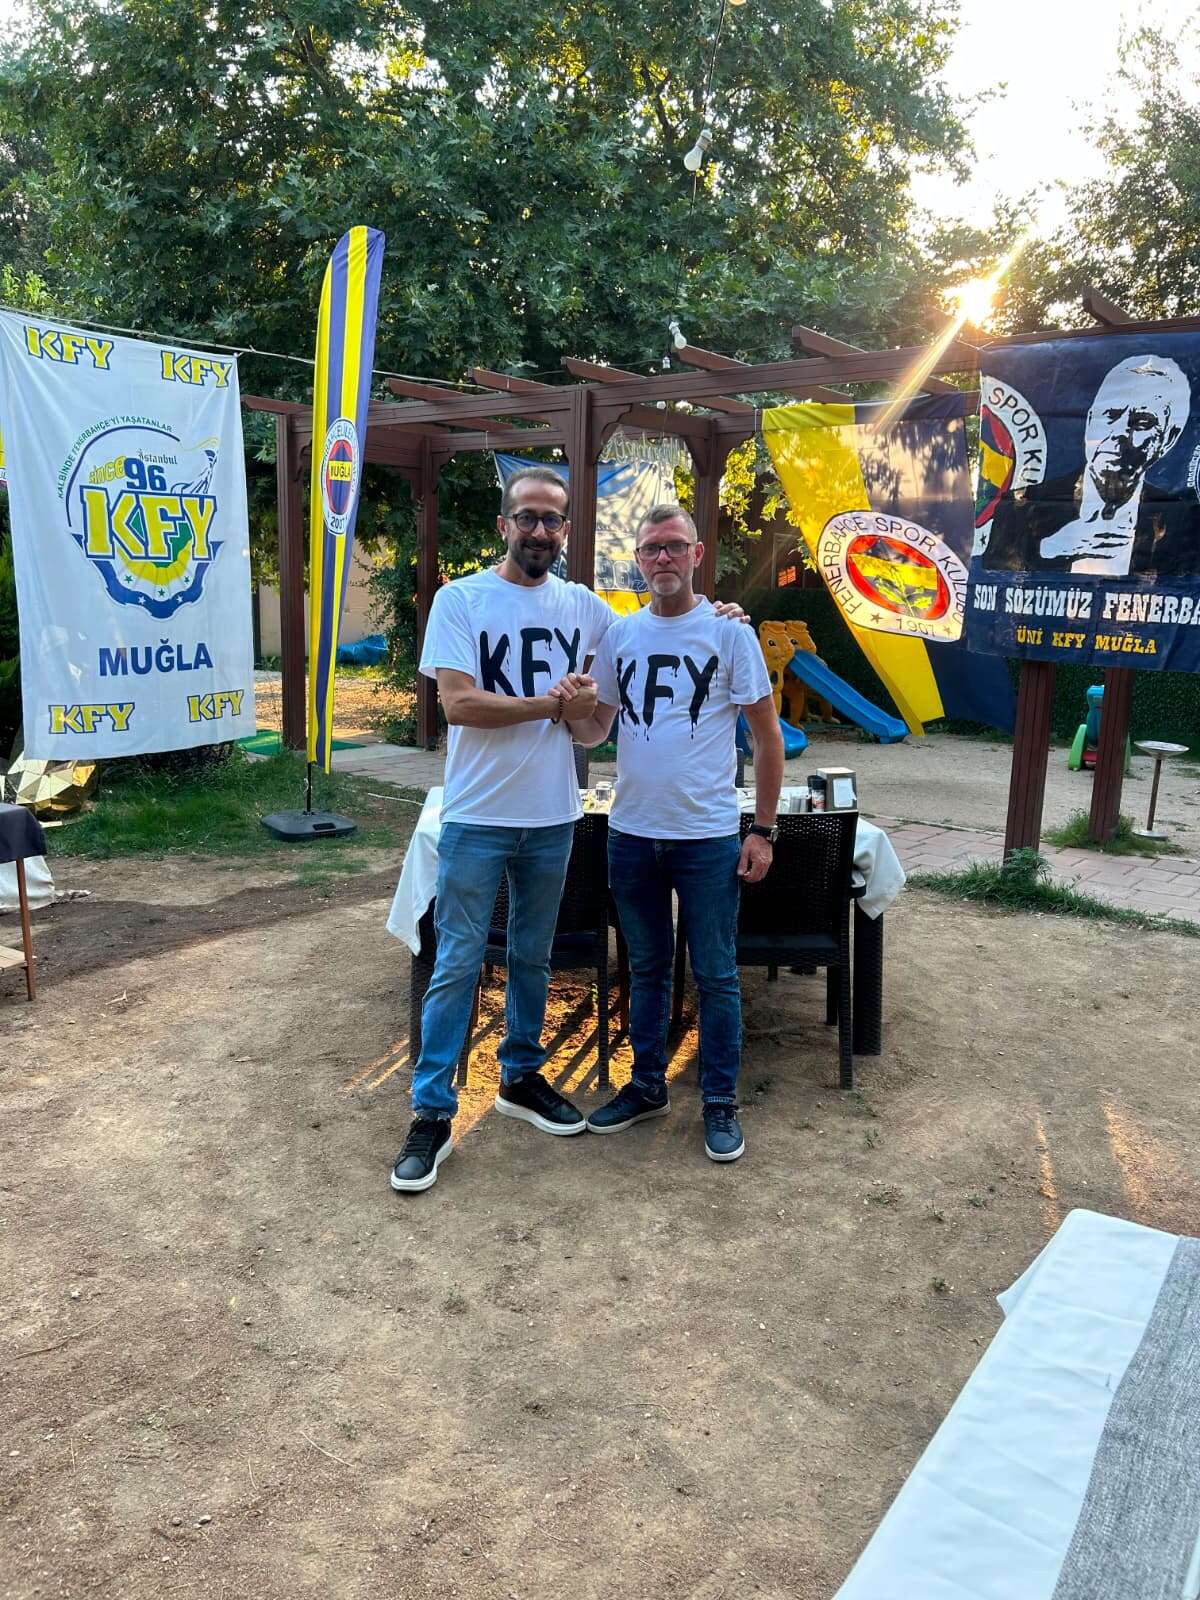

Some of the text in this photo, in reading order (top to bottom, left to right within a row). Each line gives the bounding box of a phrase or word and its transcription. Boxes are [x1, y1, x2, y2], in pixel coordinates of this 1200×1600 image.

[24, 326, 114, 370] KFY
[161, 350, 232, 388] KFY
[120, 415, 173, 432] YAŞATANLAR
[988, 387, 1039, 443] SPOR
[123, 457, 167, 491] 96
[79, 485, 218, 561] KFY
[874, 517, 936, 552] SPOR
[974, 584, 998, 611] SON
[1005, 586, 1093, 619] SÖZÜMÜZ
[895, 618, 936, 637] 1907
[1016, 625, 1157, 654] ÜNİ KFY MUĞLA
[98, 638, 214, 677] MUĞLA
[479, 627, 581, 698] KFY
[187, 689, 244, 723] KFY
[616, 653, 719, 730] KFY
[48, 702, 135, 734] KFY
